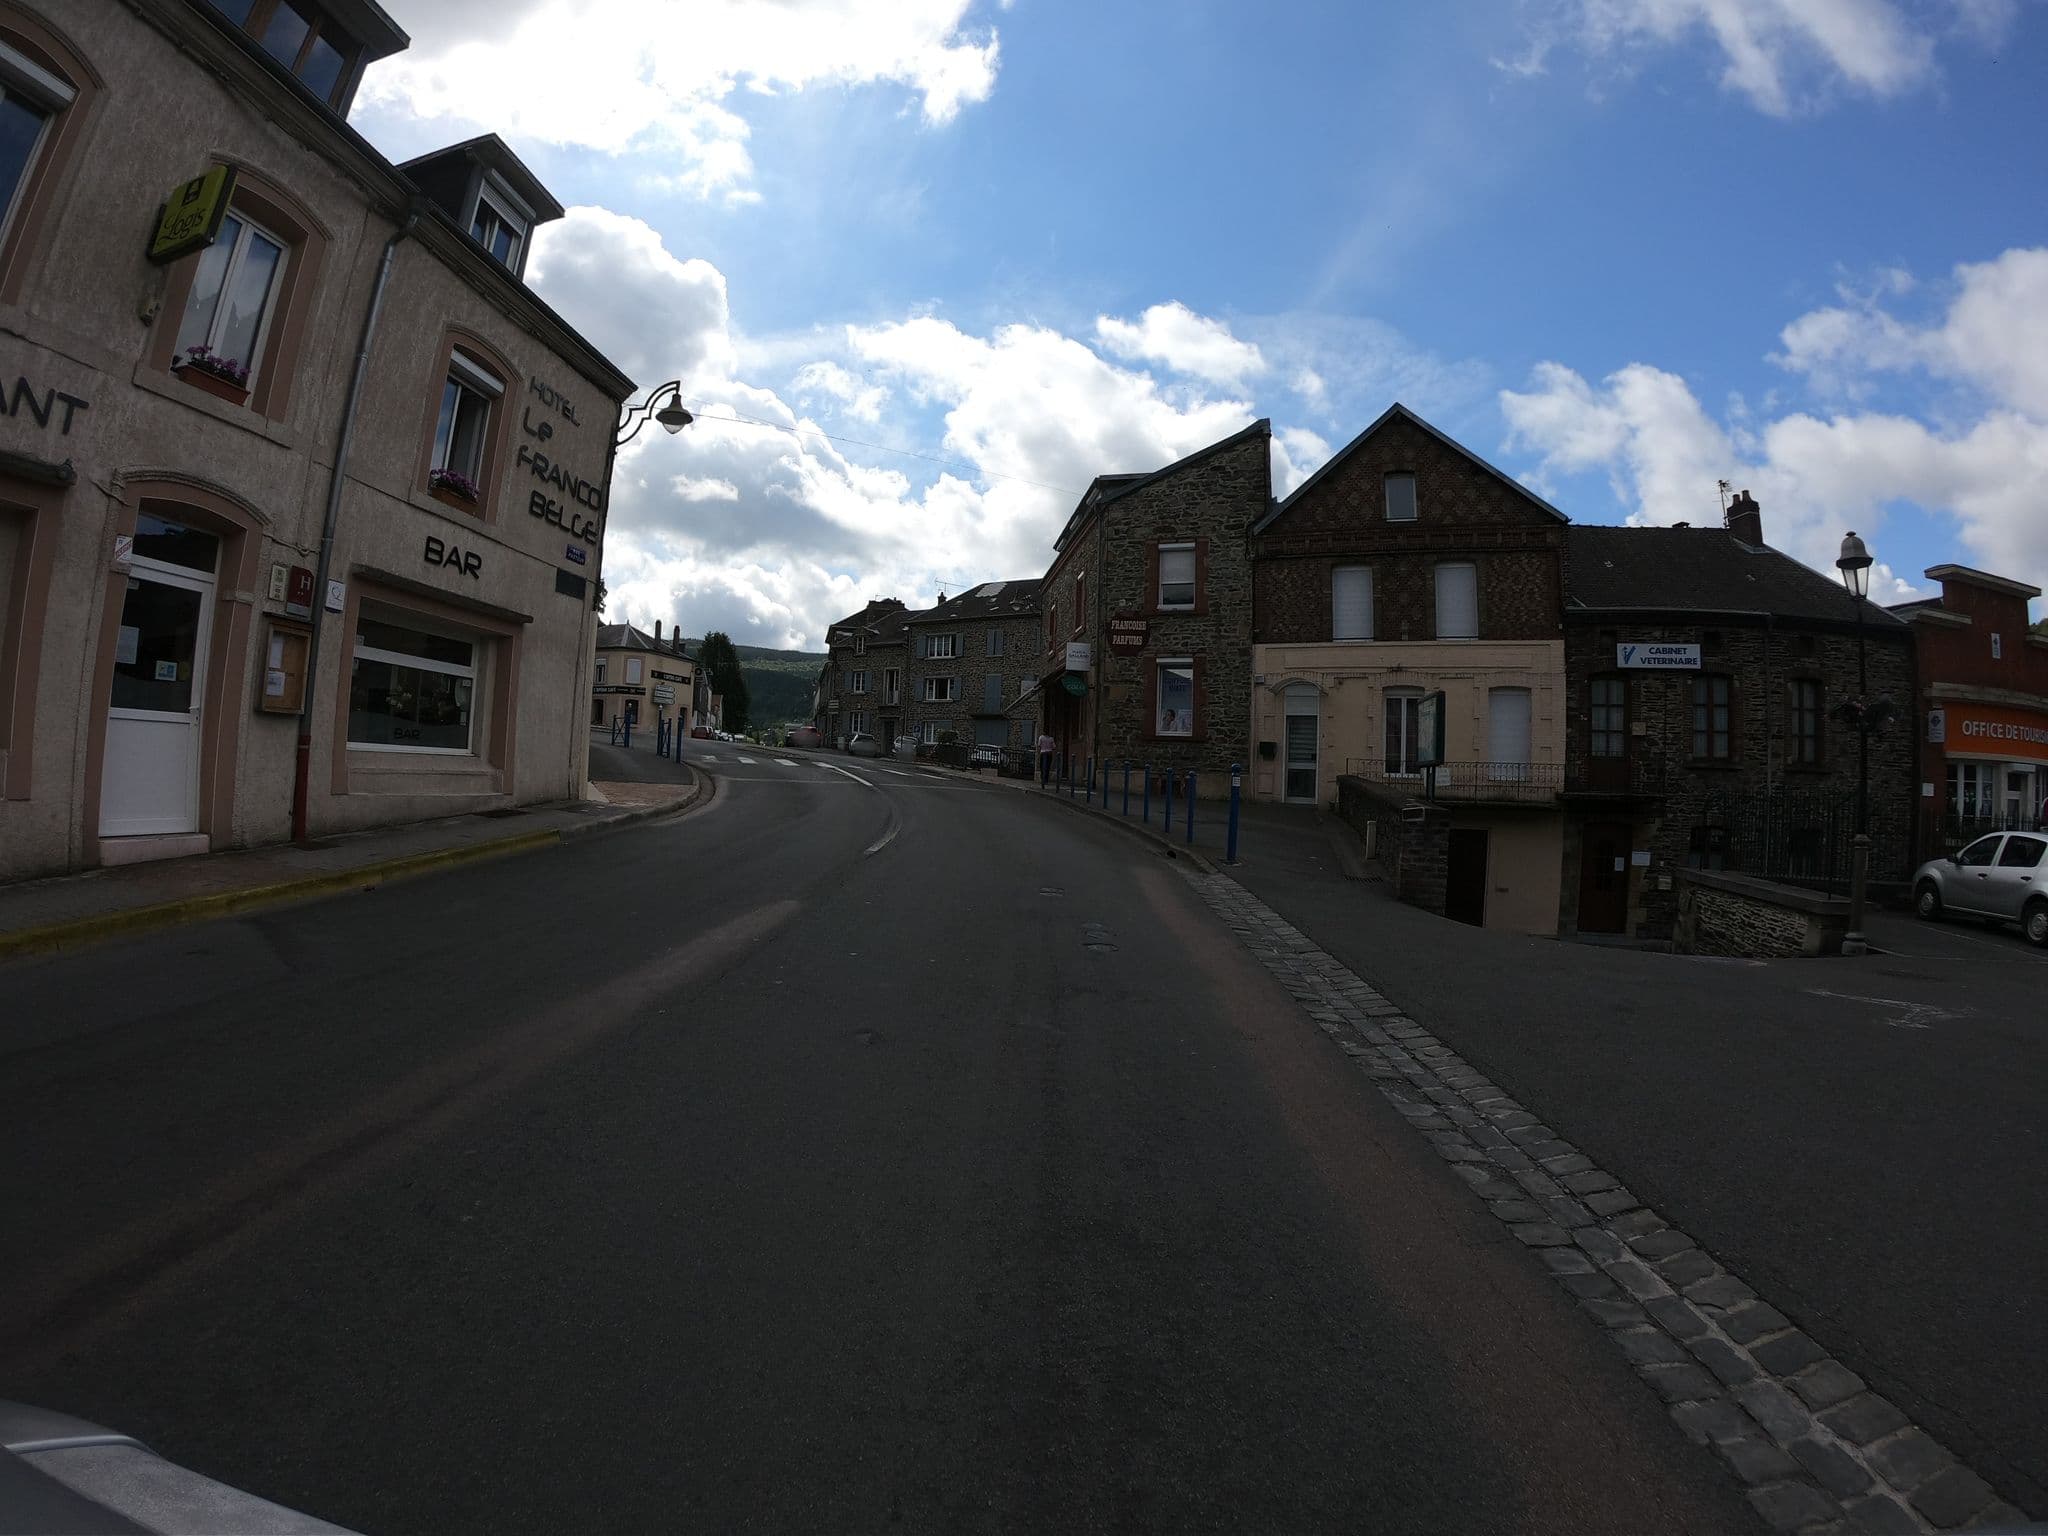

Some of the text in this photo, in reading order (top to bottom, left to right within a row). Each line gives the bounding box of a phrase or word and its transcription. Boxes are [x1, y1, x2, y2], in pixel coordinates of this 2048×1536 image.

[529, 376, 581, 428] HOTEL
[516, 445, 601, 512] FRANCO
[424, 535, 482, 580] BAR
[1648, 647, 1687, 655] CABINET
[1962, 720, 2004, 738] OFFICE
[2005, 724, 2018, 740] DE
